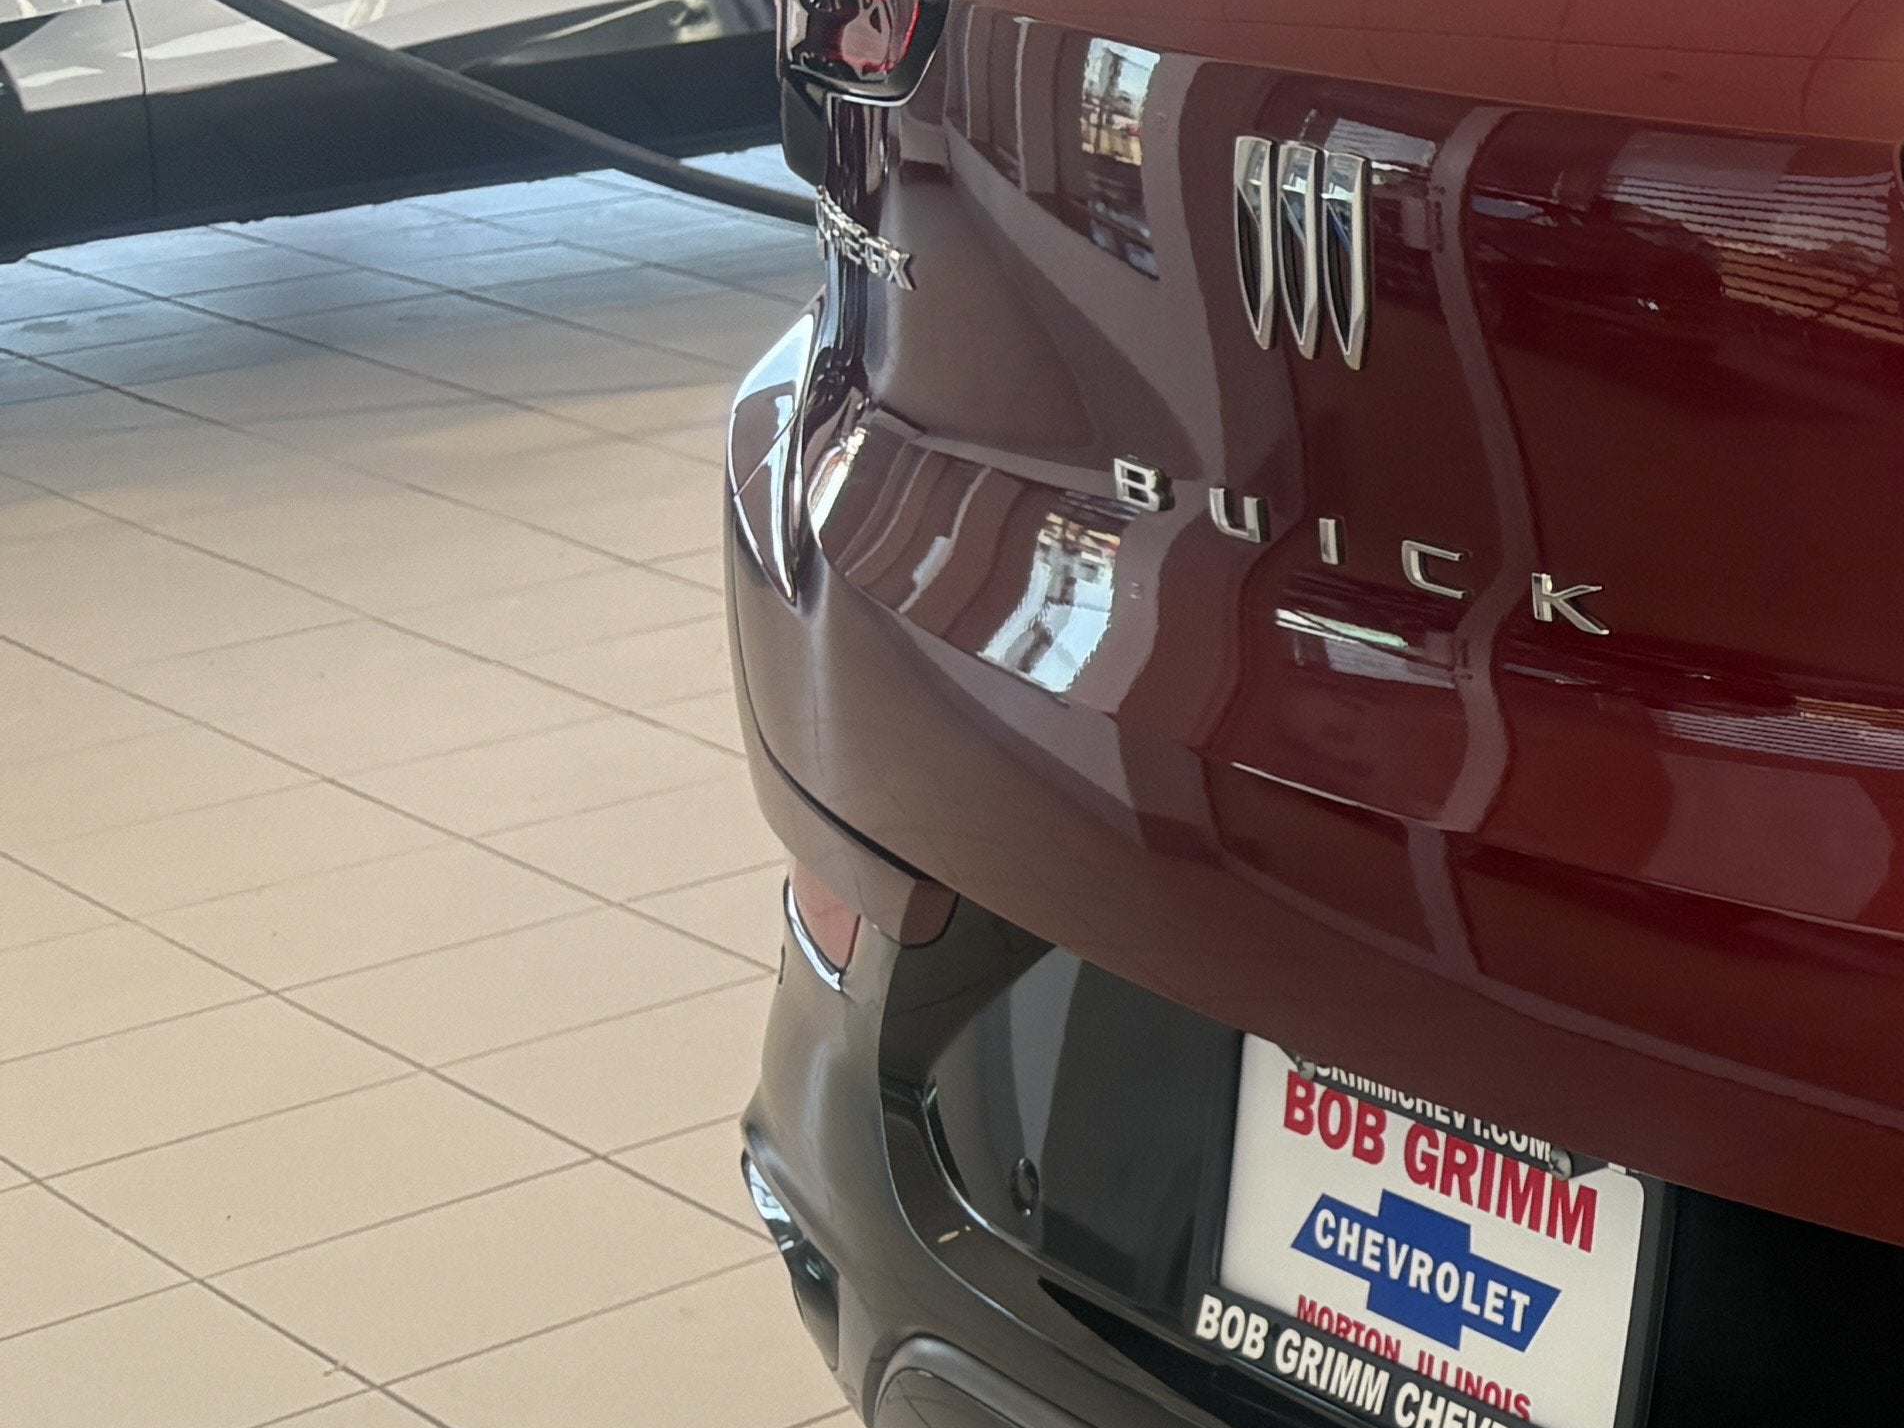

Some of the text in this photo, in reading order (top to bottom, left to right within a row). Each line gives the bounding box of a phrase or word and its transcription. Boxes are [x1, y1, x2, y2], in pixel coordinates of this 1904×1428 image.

[1114, 457, 1610, 635] BUICK
[1284, 1069, 1598, 1254] BOB GRIMM
[1314, 1208, 1531, 1333] CHEVROLET
[1196, 1294, 1269, 1360] BOB
[1275, 1329, 1390, 1415] GRIMM
[1297, 1294, 1533, 1421] MORTON ILLINOIS
